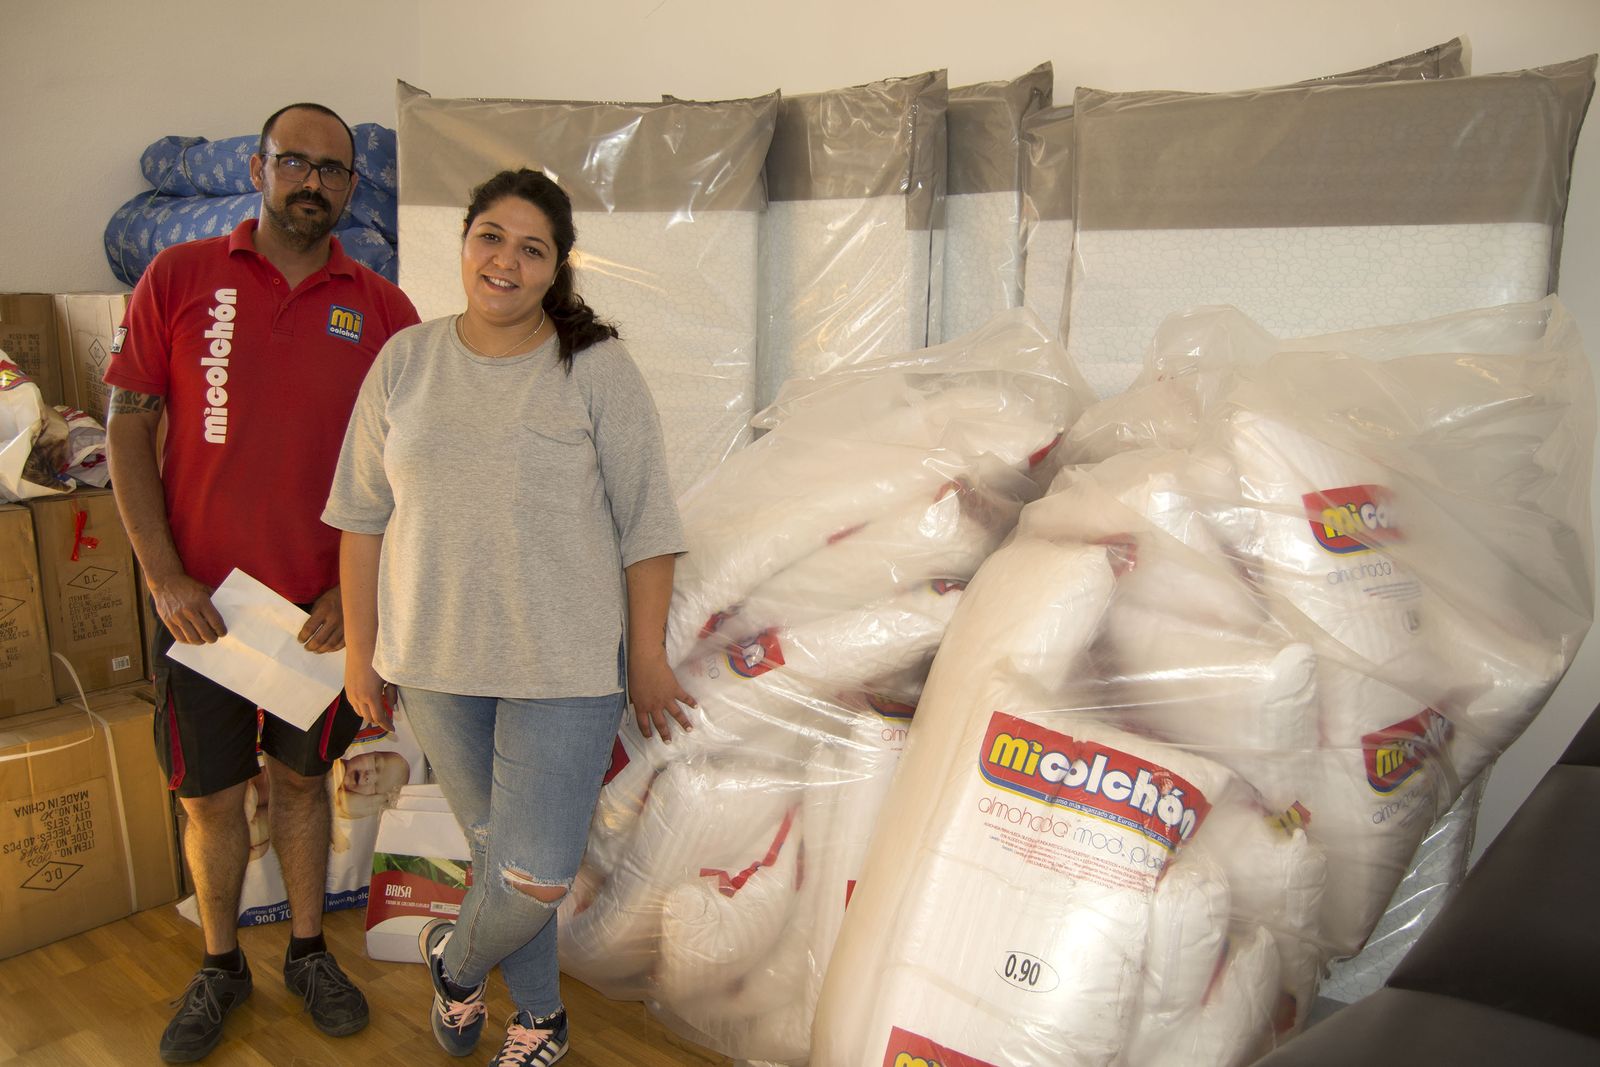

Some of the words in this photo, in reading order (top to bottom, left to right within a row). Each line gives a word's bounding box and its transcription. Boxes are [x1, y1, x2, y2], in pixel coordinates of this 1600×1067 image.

[331, 309, 361, 333] mi
[330, 326, 359, 340] colchón
[201, 288, 237, 444] micolchón
[988, 732, 1197, 841] micolchón
[47, 798, 58, 809] IN
[60, 790, 89, 806] MADE
[14, 801, 46, 818] CHINA
[978, 796, 1068, 838] almohada
[1117, 815, 1138, 829] Europa
[3, 841, 22, 854] PCS
[24, 837, 35, 848] 40
[385, 884, 412, 898] BRISA
[255, 913, 276, 925] 900
[1004, 954, 1041, 986] 0.90
